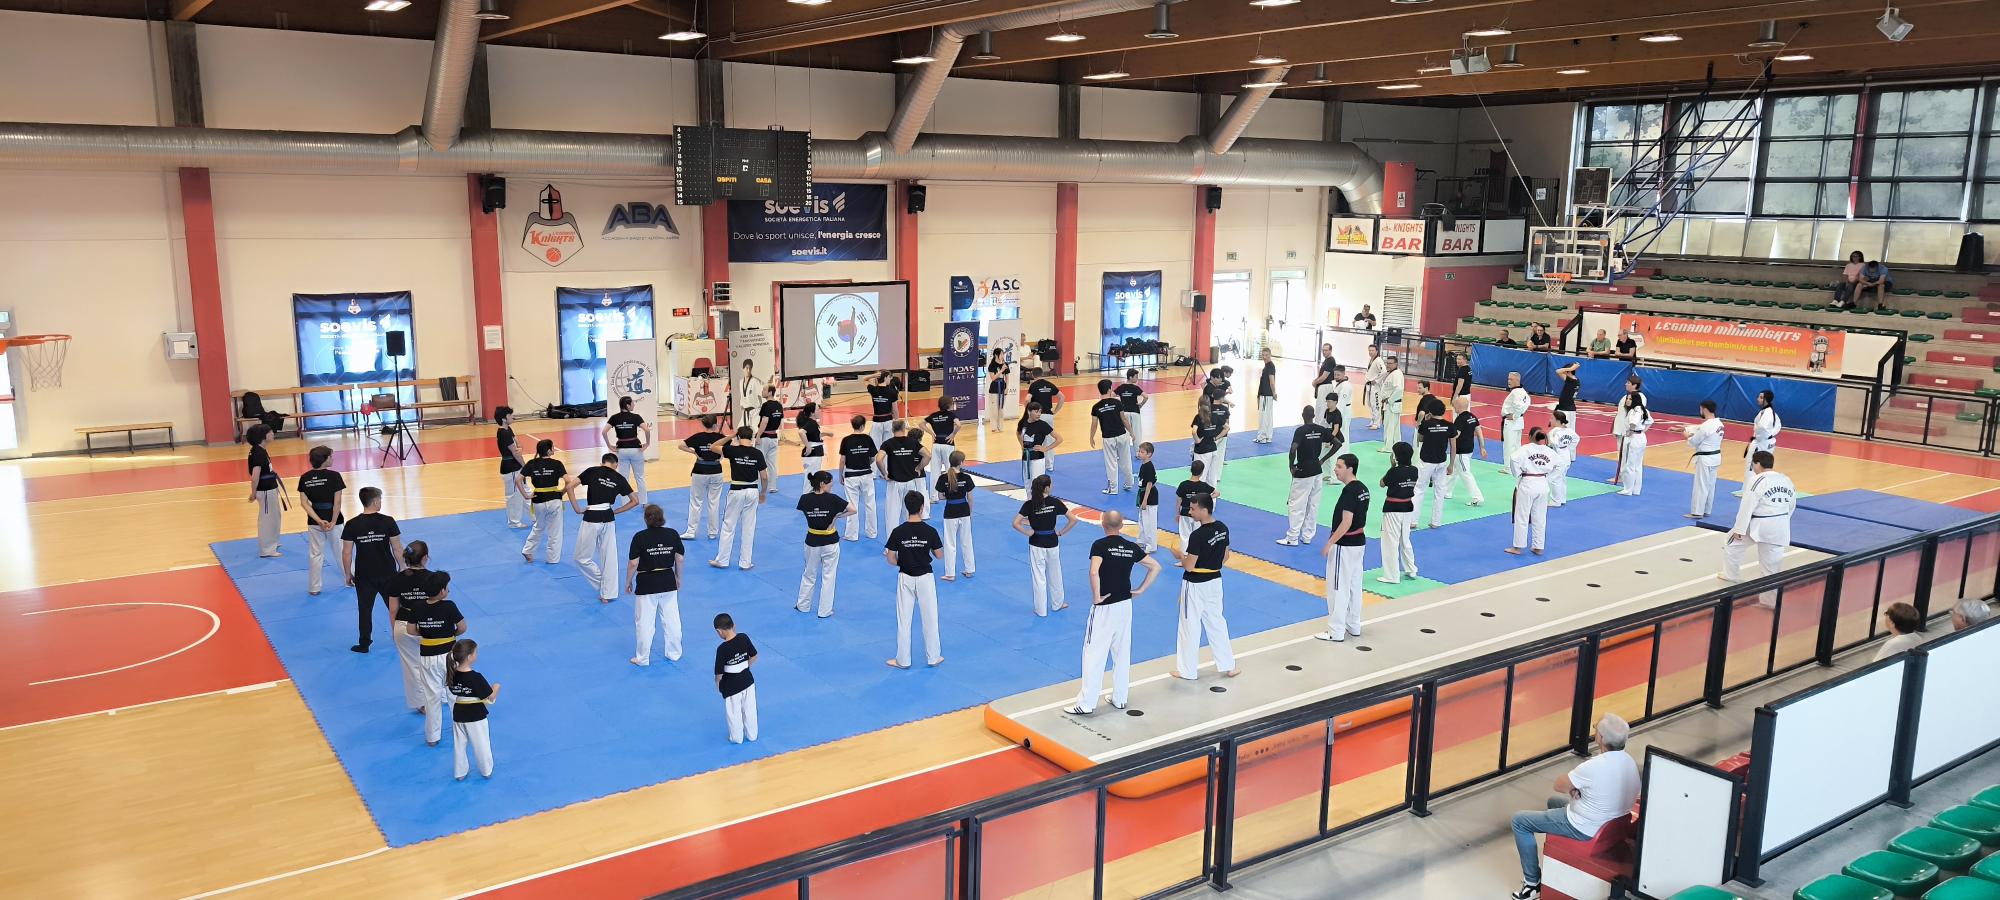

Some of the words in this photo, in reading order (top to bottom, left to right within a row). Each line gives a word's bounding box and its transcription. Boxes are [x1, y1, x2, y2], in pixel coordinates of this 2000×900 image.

[603, 202, 679, 234] ABA
[1393, 223, 1424, 233] KNIGHTS
[1454, 223, 1476, 233] NIGHTS
[733, 232, 754, 240] Dove
[756, 232, 764, 240] lo
[765, 233, 786, 241] sport
[788, 232, 817, 240] unisce,
[818, 231, 853, 241] l'energia
[1382, 237, 1422, 251] BAR
[1442, 238, 1474, 251] BAR
[791, 246, 828, 256] soevis.it
[320, 318, 377, 333] soevis
[1655, 321, 1712, 333] LEGNANO
[948, 366, 975, 374] ENDAS
[625, 367, 652, 395] 道
